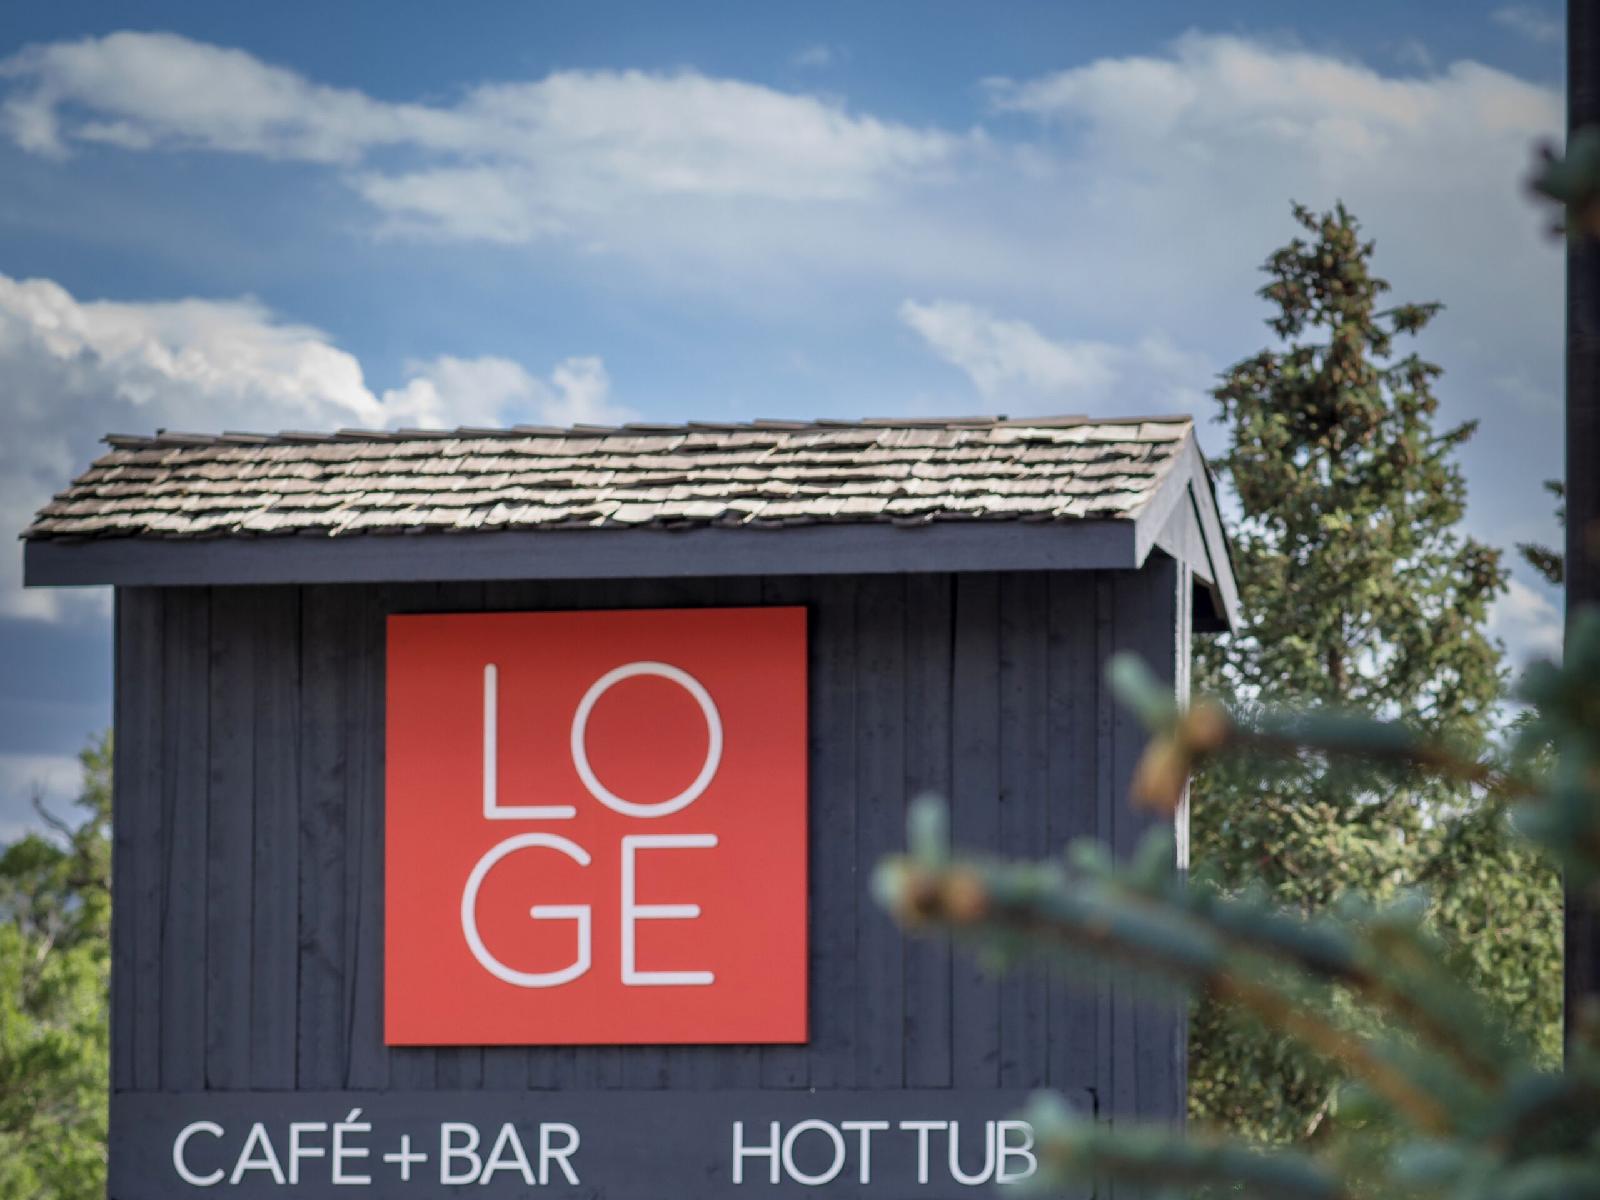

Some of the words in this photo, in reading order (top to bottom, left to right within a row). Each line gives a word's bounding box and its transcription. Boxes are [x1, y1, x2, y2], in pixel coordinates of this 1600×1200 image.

[482, 660, 723, 820] LO
[460, 832, 718, 988] GE
[732, 1118, 890, 1187] HOT
[899, 1118, 1039, 1187] TUB
